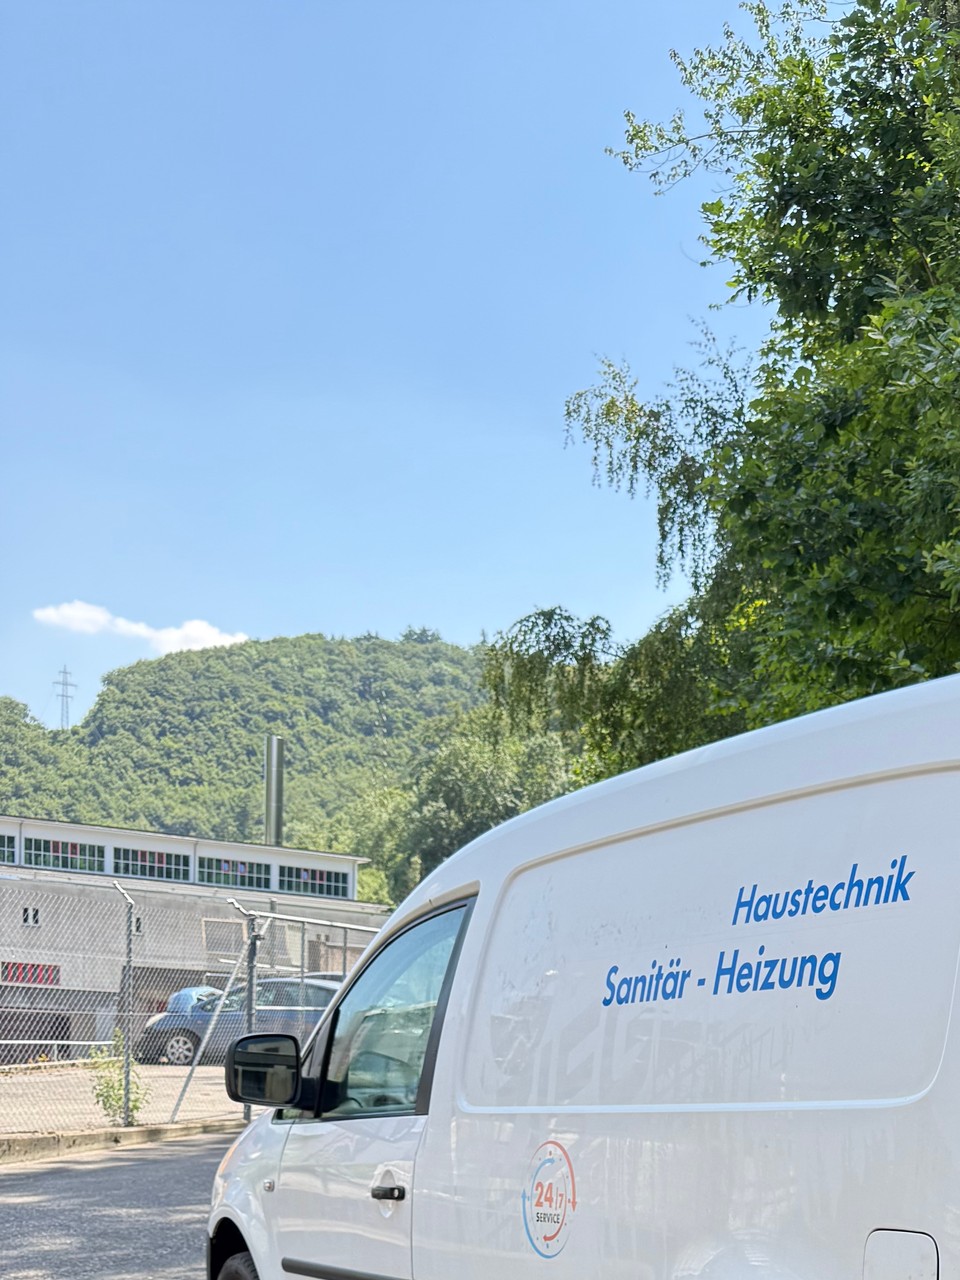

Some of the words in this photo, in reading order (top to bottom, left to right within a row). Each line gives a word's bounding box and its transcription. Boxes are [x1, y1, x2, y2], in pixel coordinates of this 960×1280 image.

[732, 855, 916, 926] Haustechnik
[602, 957, 692, 1007] Sanitär
[713, 945, 842, 1001] Heizung
[536, 1212, 560, 1224] SERVICE
